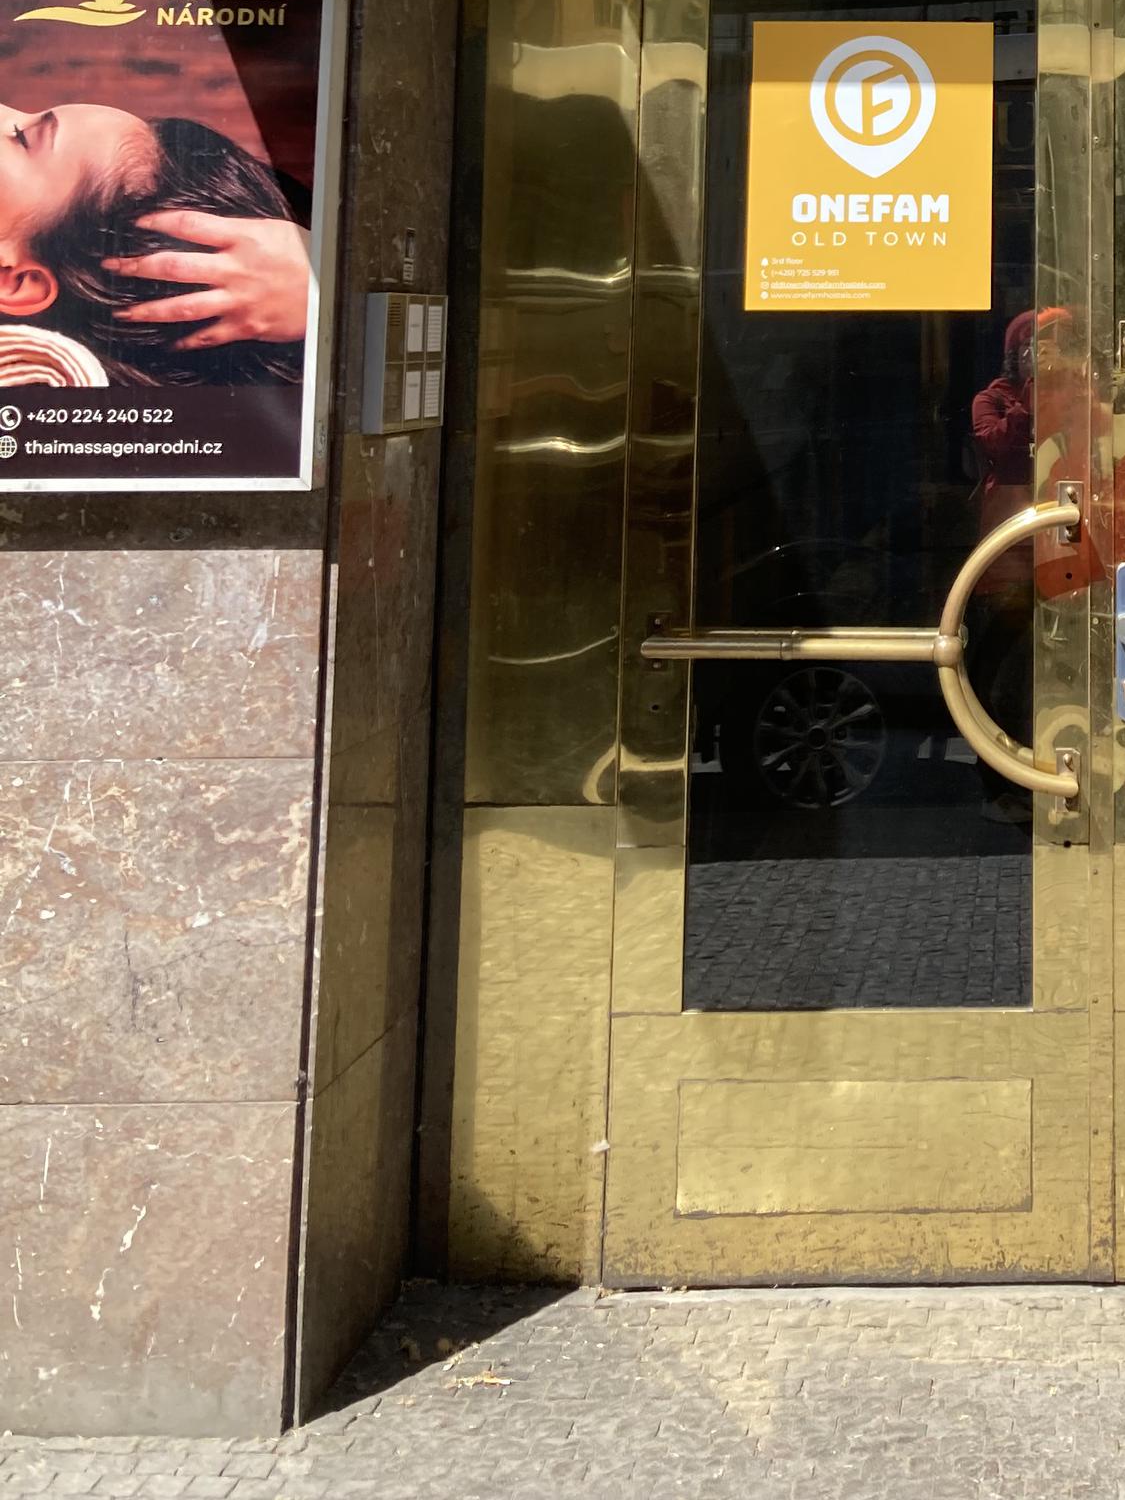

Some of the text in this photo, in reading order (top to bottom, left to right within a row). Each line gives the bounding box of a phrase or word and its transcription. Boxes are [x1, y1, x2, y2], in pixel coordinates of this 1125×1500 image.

[156, 2, 287, 26] NÁRODNÍ
[791, 194, 950, 223] ONEFAM
[791, 231, 947, 246] OLD TOWN
[27, 409, 174, 424] +420 224 240 522
[25, 439, 223, 457] thaimassagenarodni.cz
